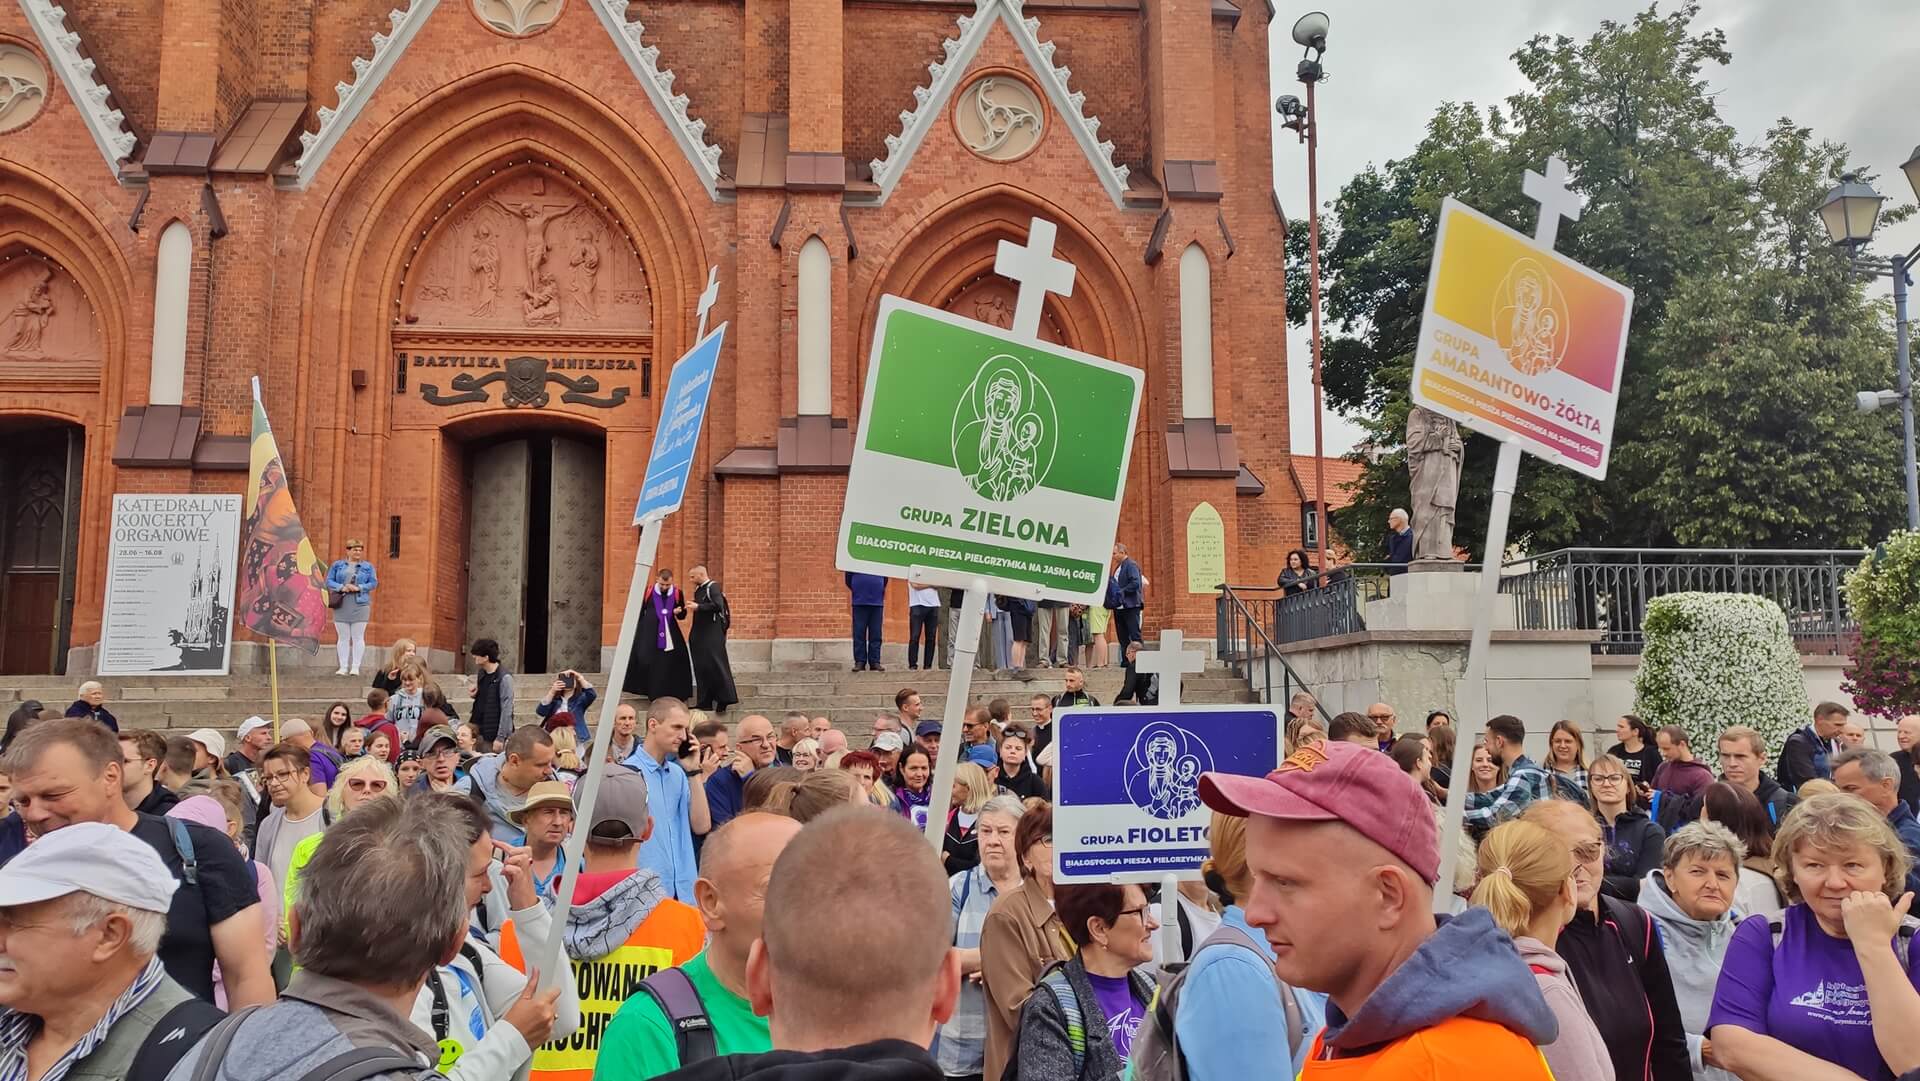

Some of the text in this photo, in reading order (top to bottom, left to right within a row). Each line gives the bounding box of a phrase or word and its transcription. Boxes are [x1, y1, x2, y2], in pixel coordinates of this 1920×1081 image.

[1433, 328, 1480, 359] GRUPA
[413, 356, 637, 370] BAZYLIKA MNIEJSZA
[1430, 349, 1602, 435] AMARANTOWO-ŻÓŁTA
[117, 499, 236, 512] KATEDRALNE
[116, 512, 212, 527] KONCERTY
[900, 506, 1070, 548] GRUPA ZIELONA
[115, 528, 210, 542] ORGANOWE
[855, 535, 1096, 584] BIAŁOSTOCKA PIESZA PIELGRZYMKA NA JASNĄ GÓRĘ
[1080, 835, 1124, 846] GRUPA
[1123, 857, 1152, 865] PIESZA
[1153, 855, 1208, 864] PIELGRZYMKA
[571, 962, 658, 1002] OWANI
